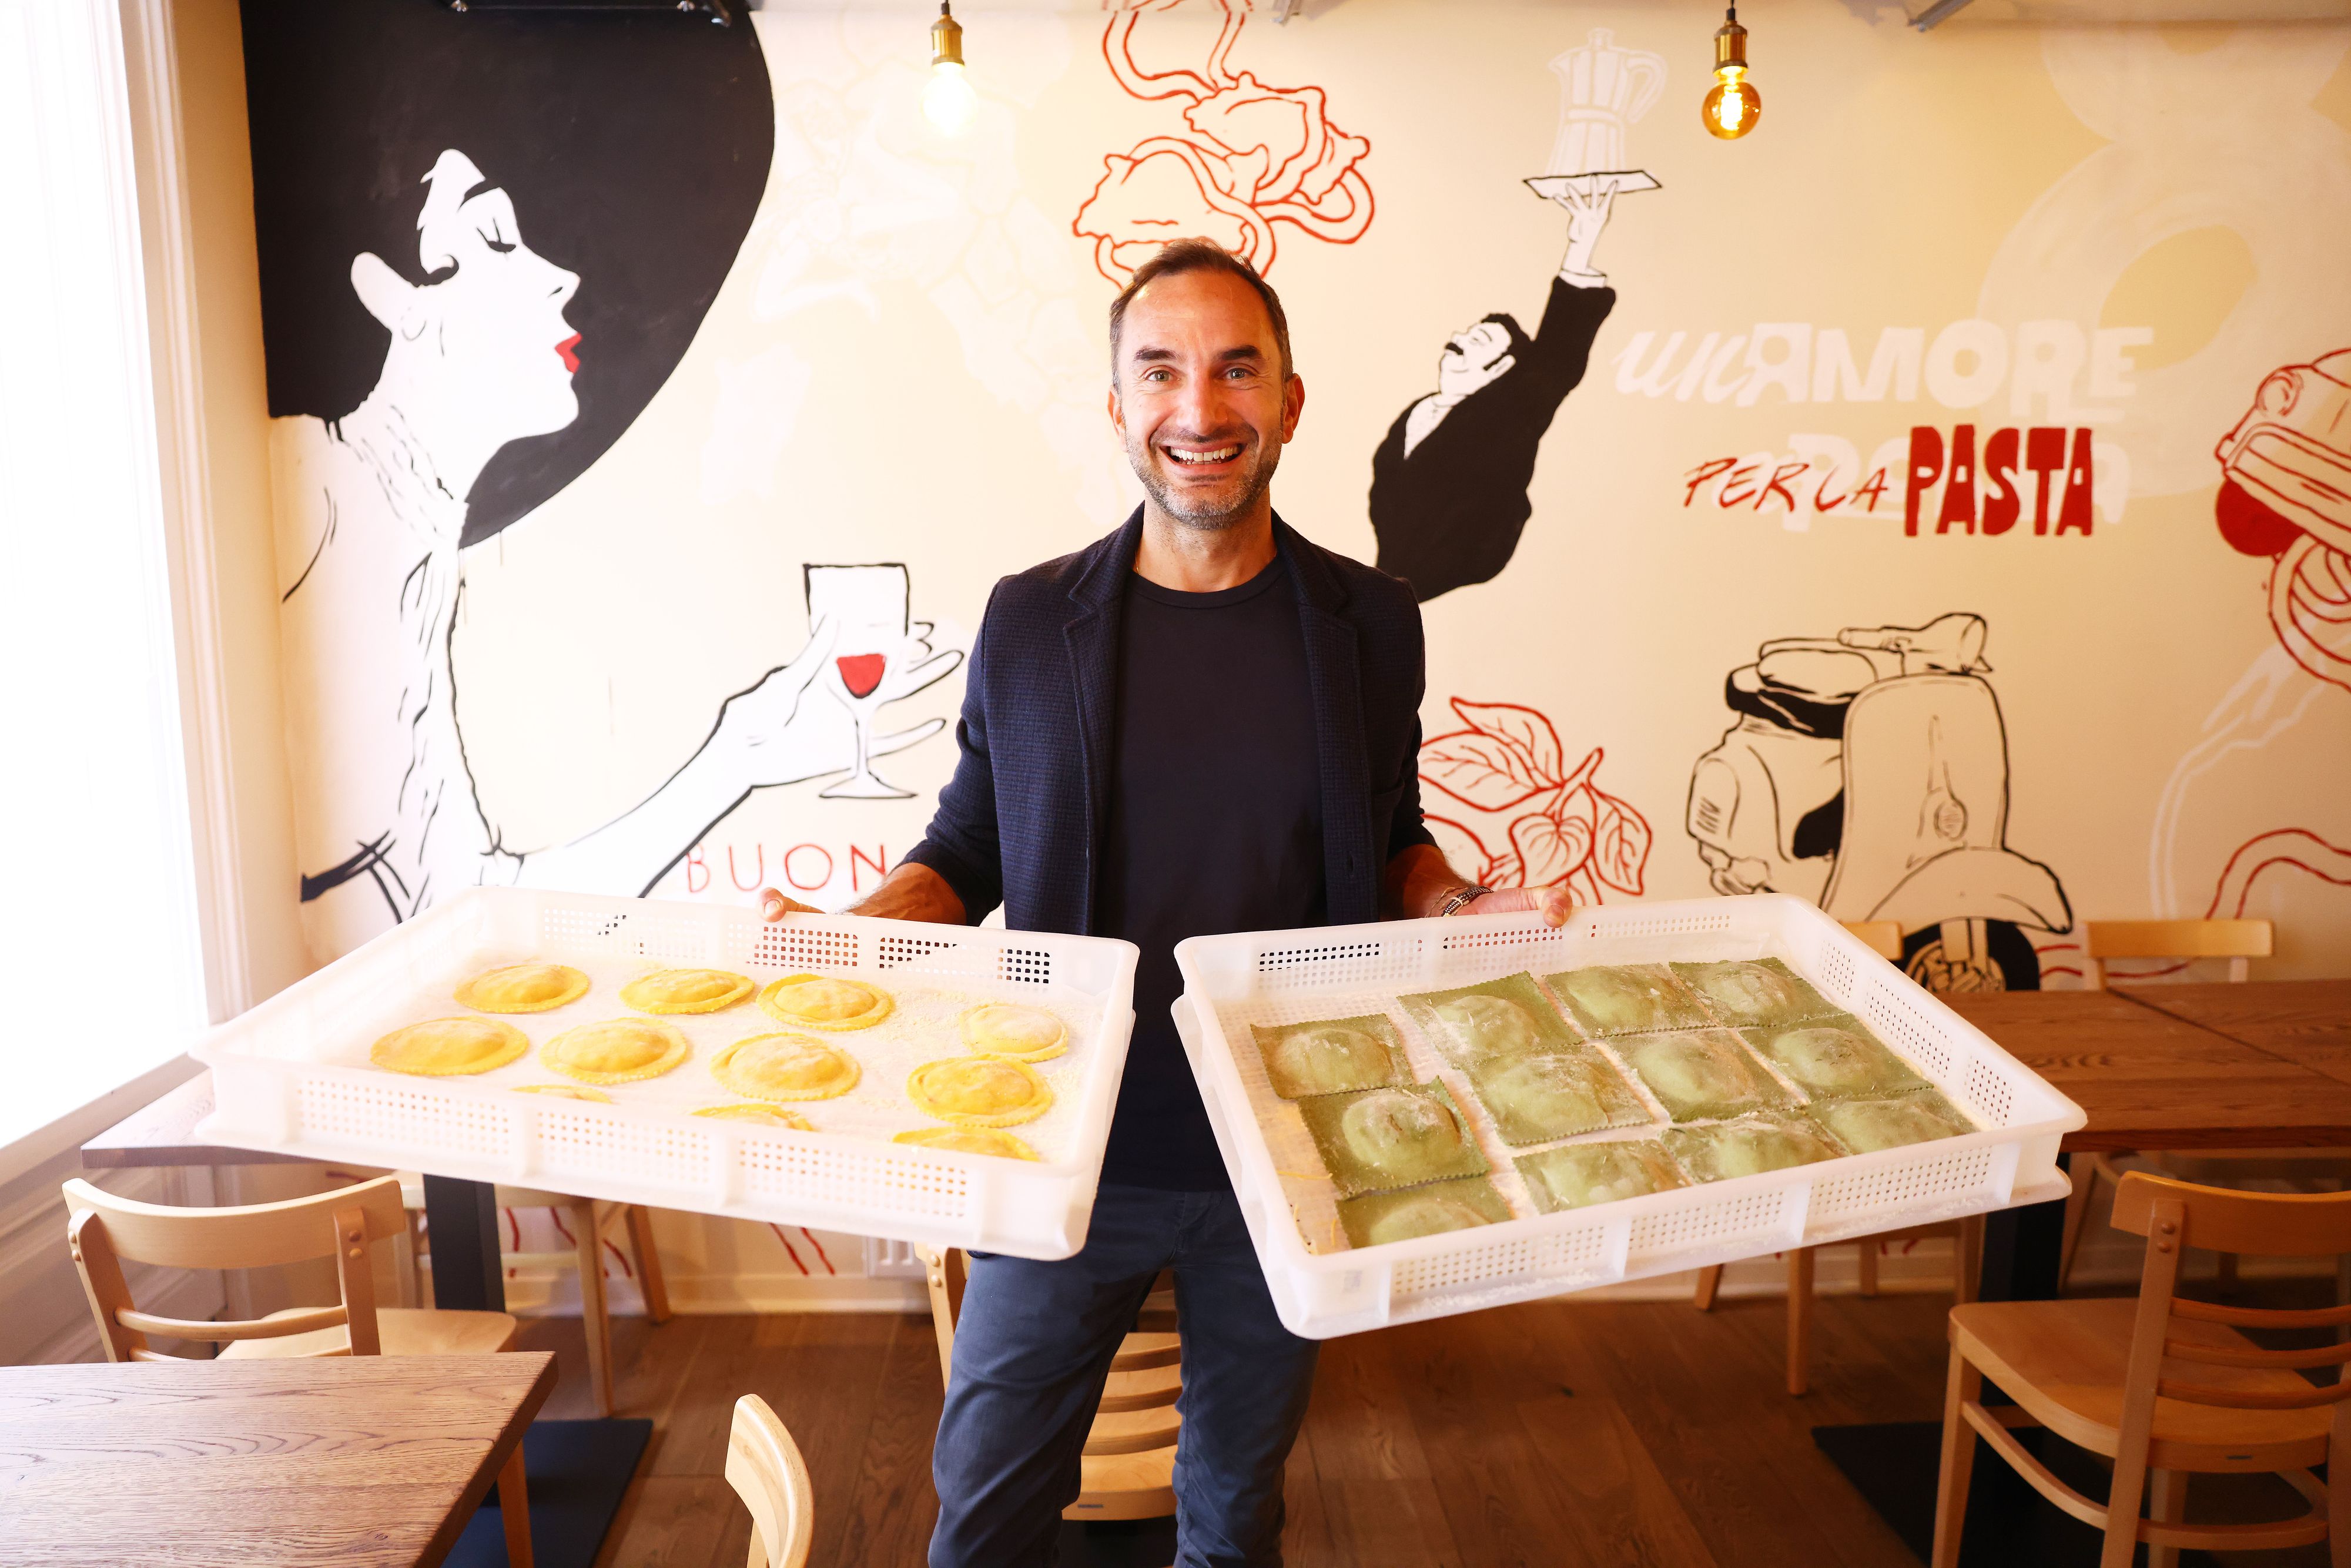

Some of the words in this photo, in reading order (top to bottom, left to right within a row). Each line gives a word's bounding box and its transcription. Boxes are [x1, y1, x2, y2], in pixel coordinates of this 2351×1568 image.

[1736, 322, 2154, 423] AMORE
[1904, 424, 2094, 537] PASTA
[686, 843, 886, 893] BUON
